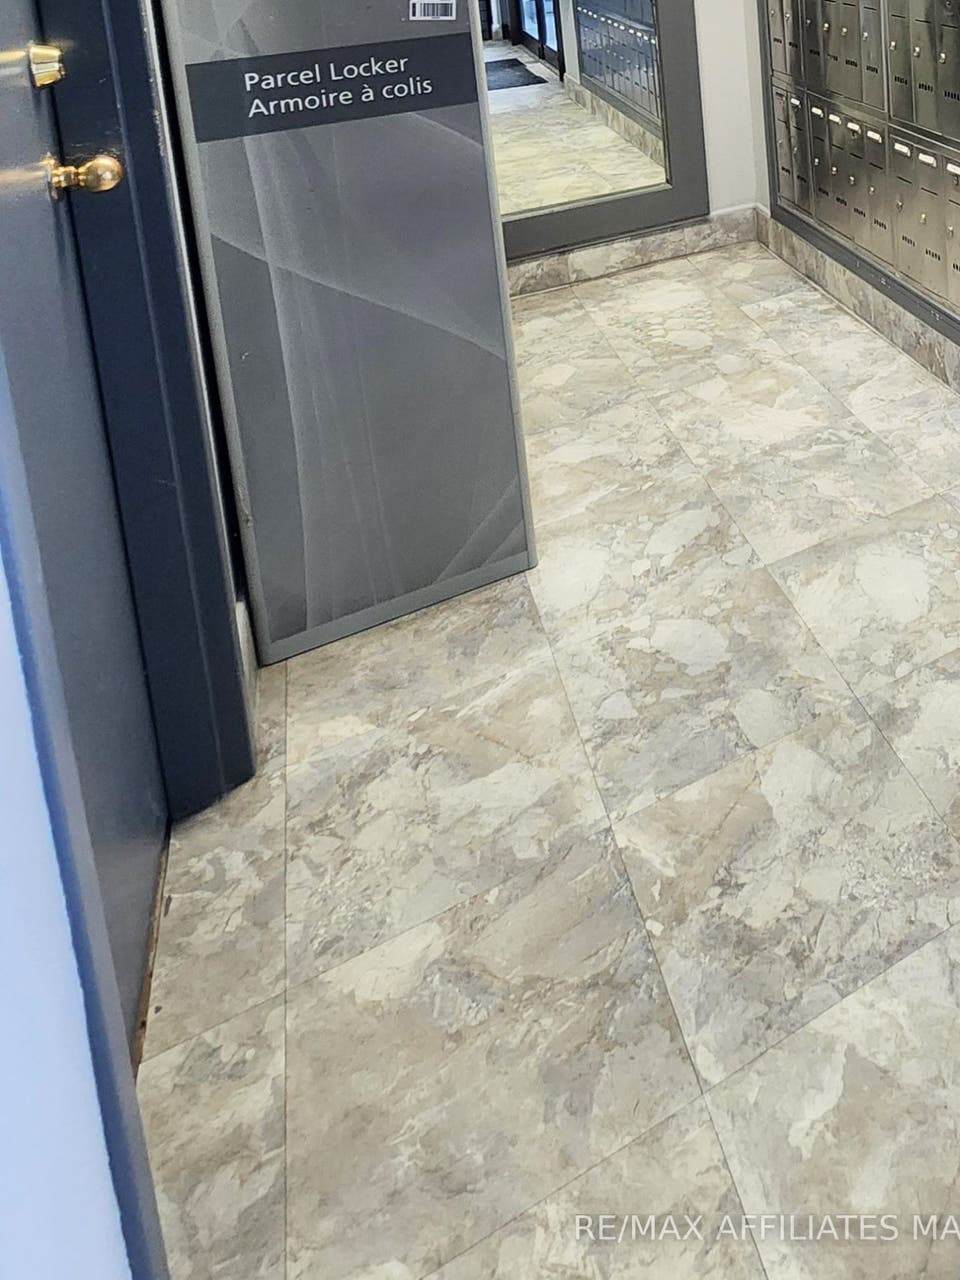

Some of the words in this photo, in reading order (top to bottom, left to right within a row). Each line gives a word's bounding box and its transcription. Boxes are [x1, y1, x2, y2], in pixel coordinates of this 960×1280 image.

[244, 64, 320, 92] Parcel
[329, 57, 409, 81] Locker
[248, 87, 353, 118] Armoire
[360, 84, 375, 102] à
[381, 77, 433, 99] colis
